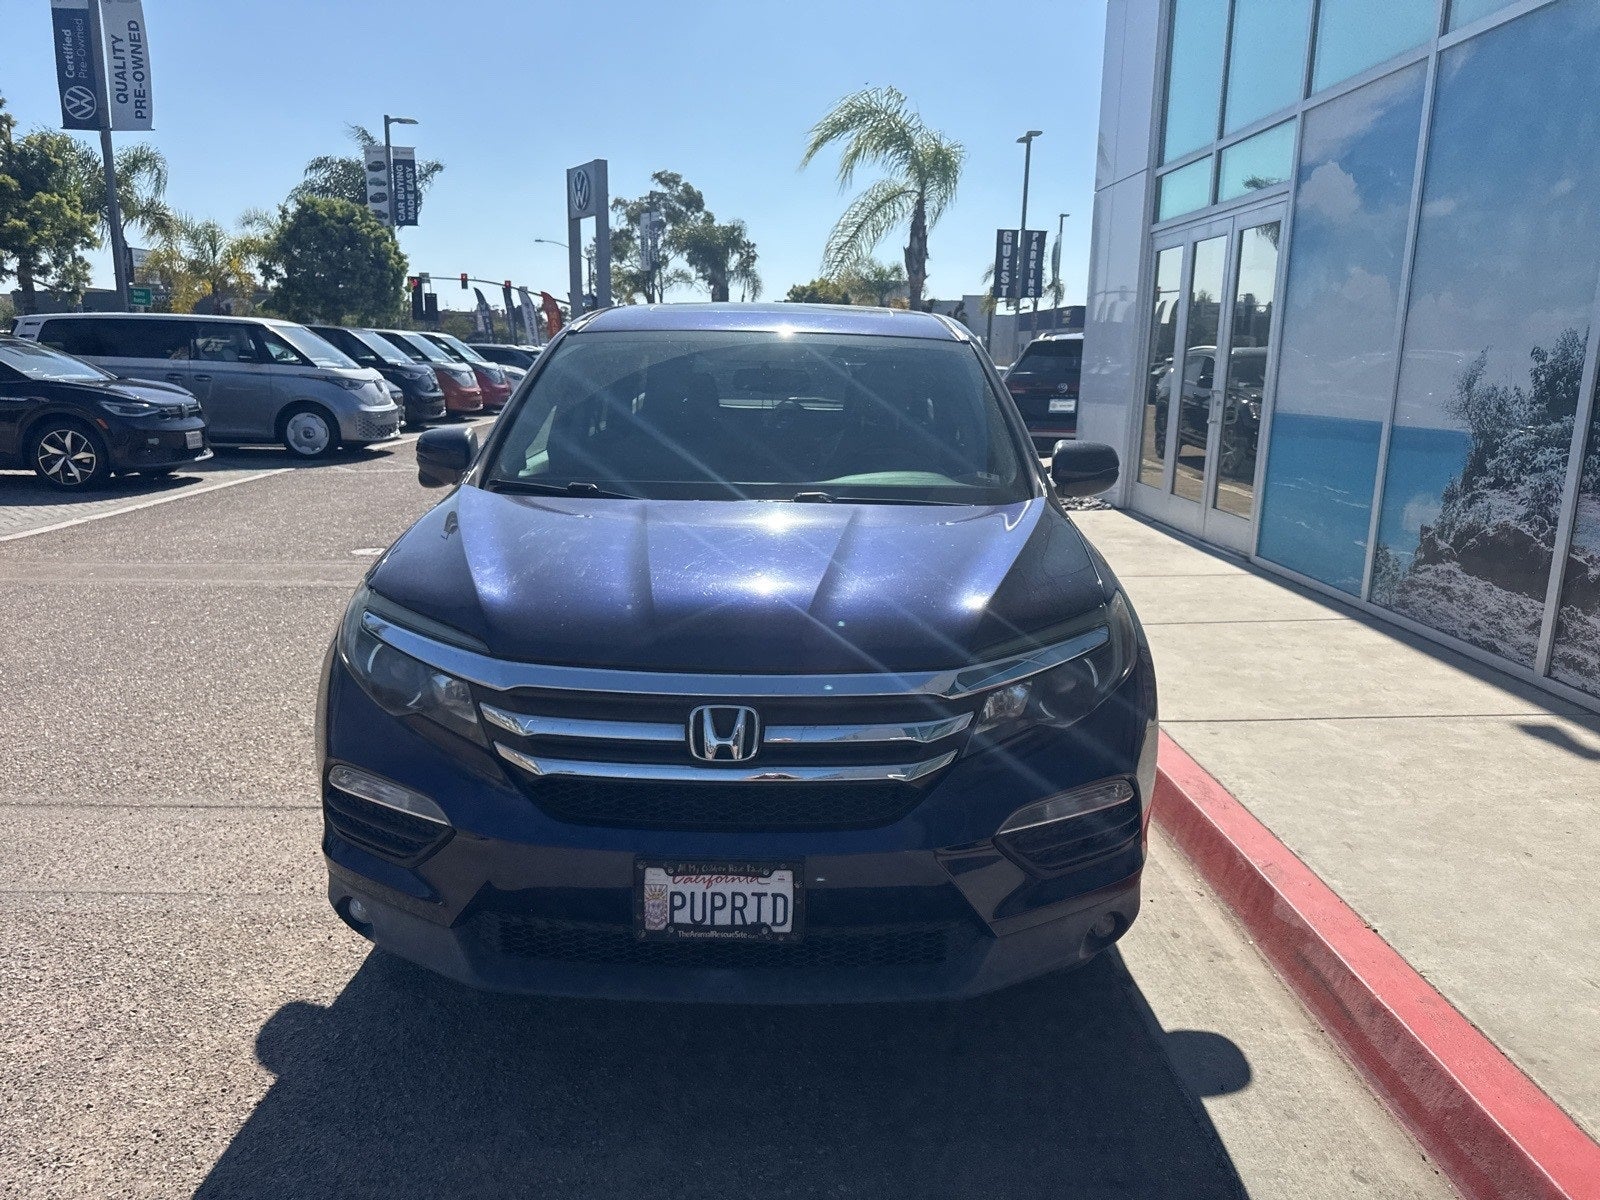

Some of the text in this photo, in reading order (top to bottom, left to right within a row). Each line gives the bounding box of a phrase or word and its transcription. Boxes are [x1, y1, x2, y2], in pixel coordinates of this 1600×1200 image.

[62, 28, 76, 79] Certified
[73, 18, 88, 79] Pre-Owned
[110, 34, 129, 105] QUALITY
[127, 19, 147, 120] PRE-OWNED
[395, 164, 405, 200] BUYING
[405, 166, 416, 221] MADE EASY
[397, 201, 406, 222] CAR
[1000, 230, 1013, 297] GUEST
[1026, 231, 1040, 297] PARKING
[671, 874, 770, 890] California
